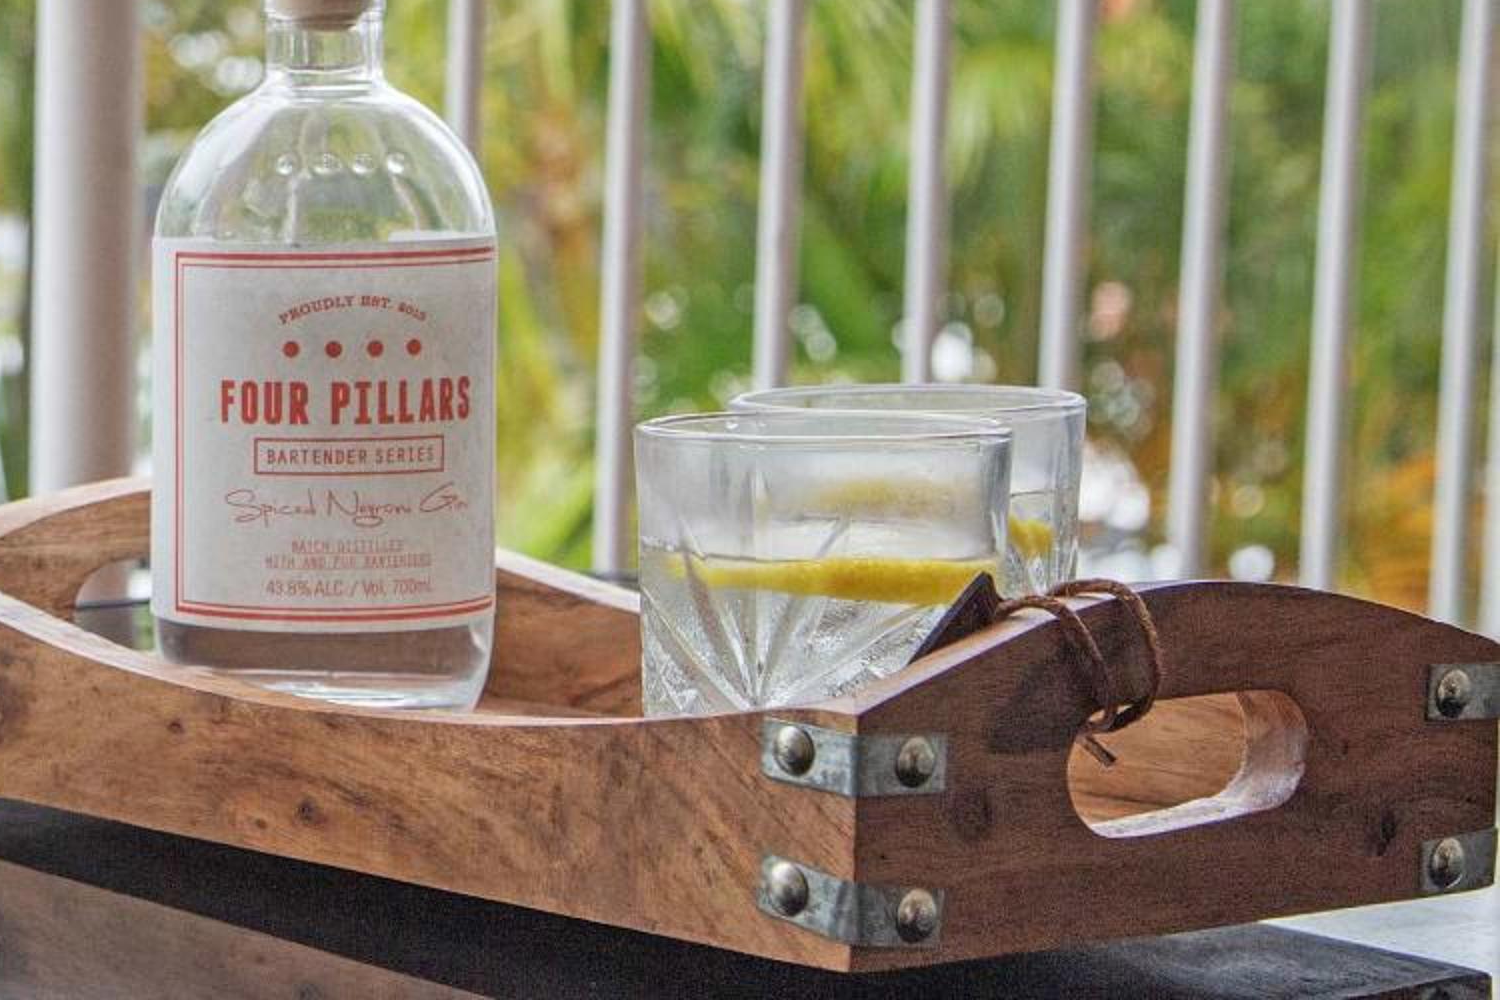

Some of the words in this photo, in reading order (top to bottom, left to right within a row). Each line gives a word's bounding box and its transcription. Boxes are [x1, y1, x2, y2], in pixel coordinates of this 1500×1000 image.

[278, 295, 355, 324] PROUDLY
[220, 379, 310, 425] FOUR
[330, 376, 471, 425] PILLARS
[266, 448, 367, 465] BARTENDER
[375, 446, 435, 464] SERIES
[224, 488, 317, 528] Spiced
[418, 481, 469, 514] Gin
